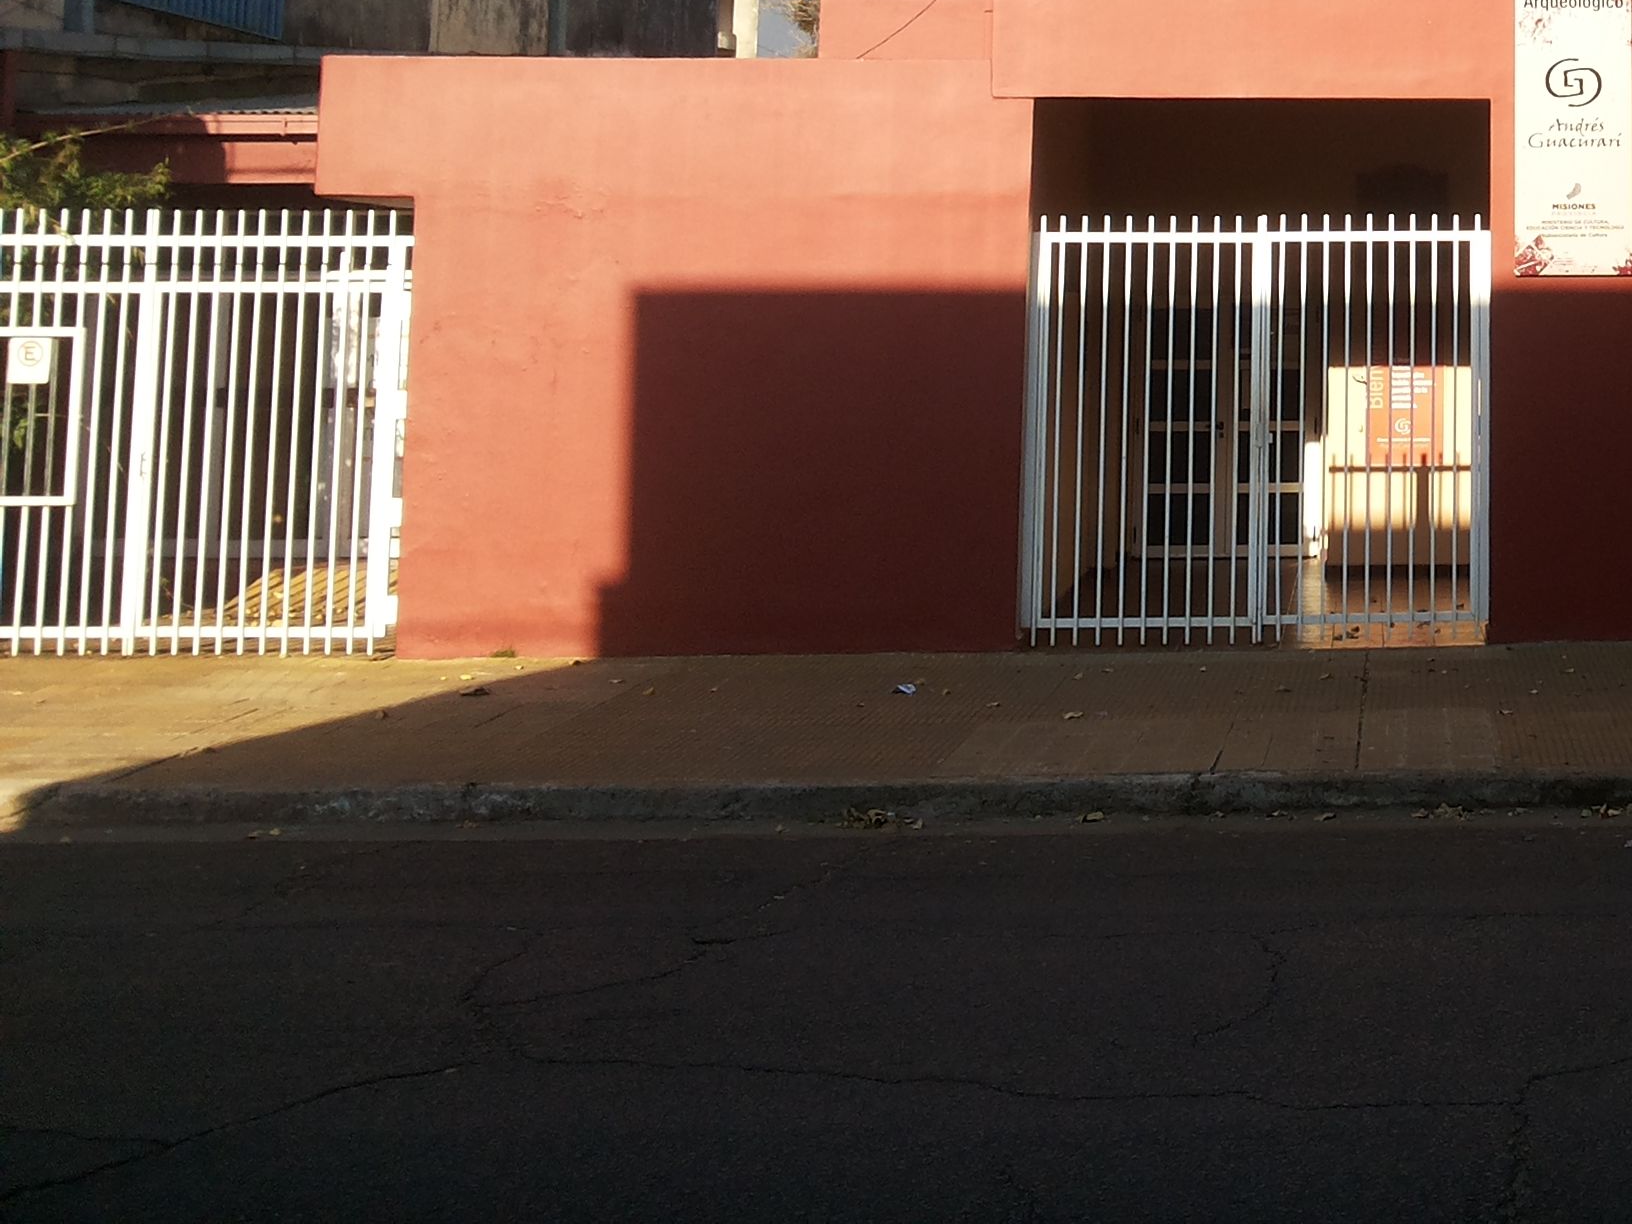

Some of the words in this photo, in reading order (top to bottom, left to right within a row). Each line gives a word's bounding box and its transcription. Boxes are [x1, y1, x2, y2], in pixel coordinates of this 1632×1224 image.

[1548, 117, 1605, 137] Andrés
[1527, 132, 1623, 149] Guacurarí
[23, 345, 37, 362] E
